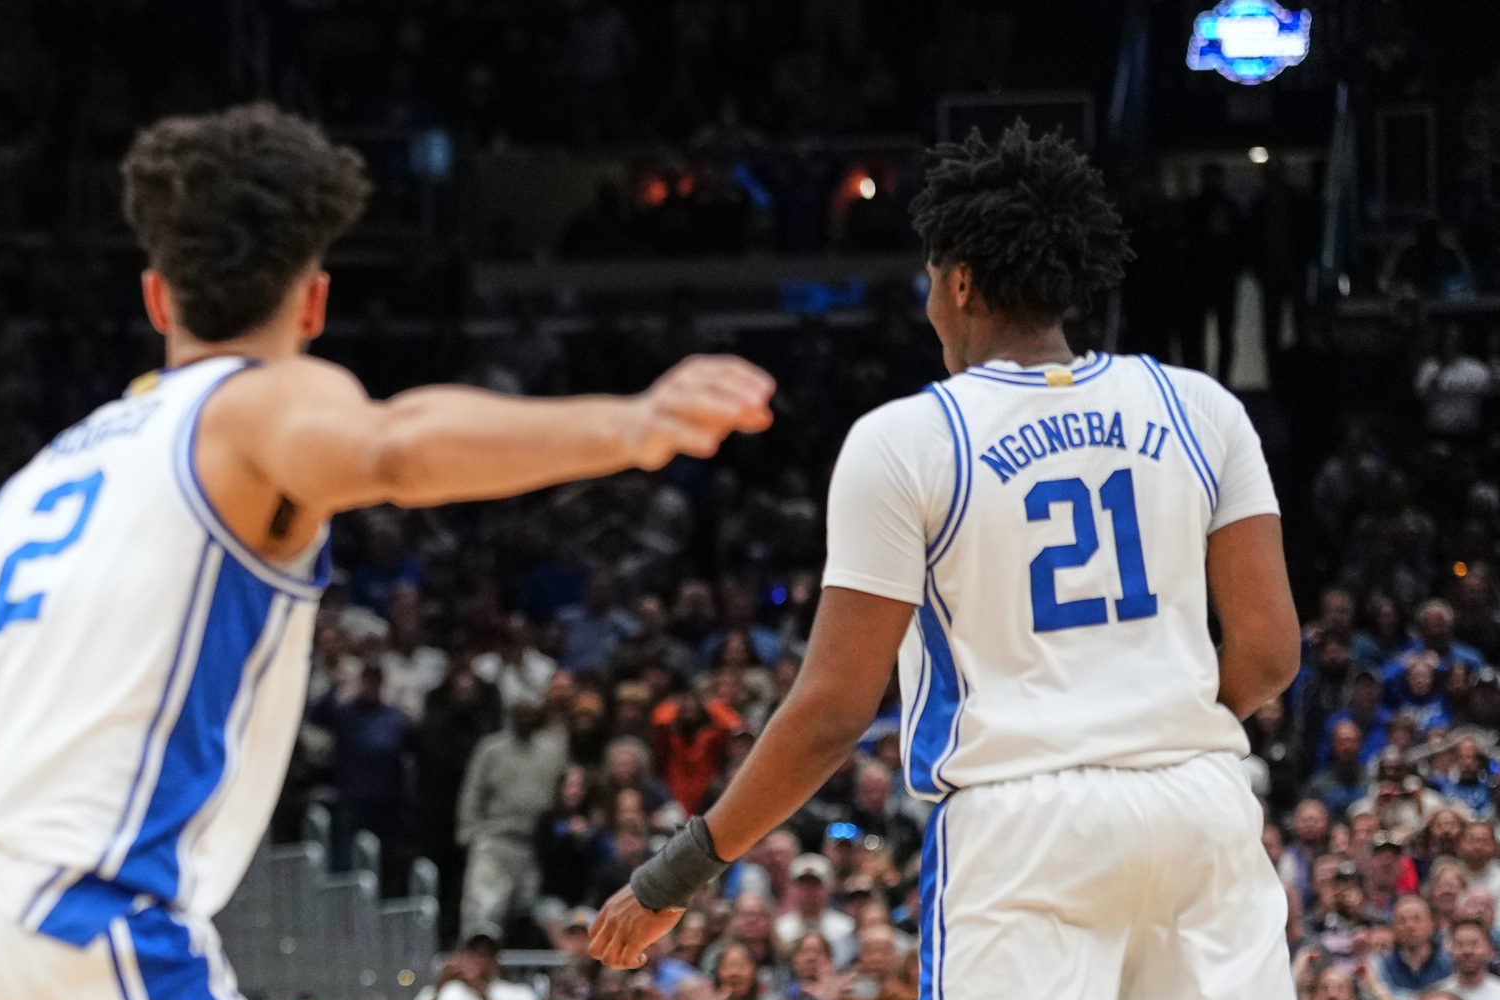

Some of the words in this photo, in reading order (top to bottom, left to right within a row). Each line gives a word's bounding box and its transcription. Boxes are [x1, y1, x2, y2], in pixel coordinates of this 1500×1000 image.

[979, 411, 1127, 485] NGONGBA
[1139, 420, 1170, 462] II
[1024, 468, 1157, 633] 21
